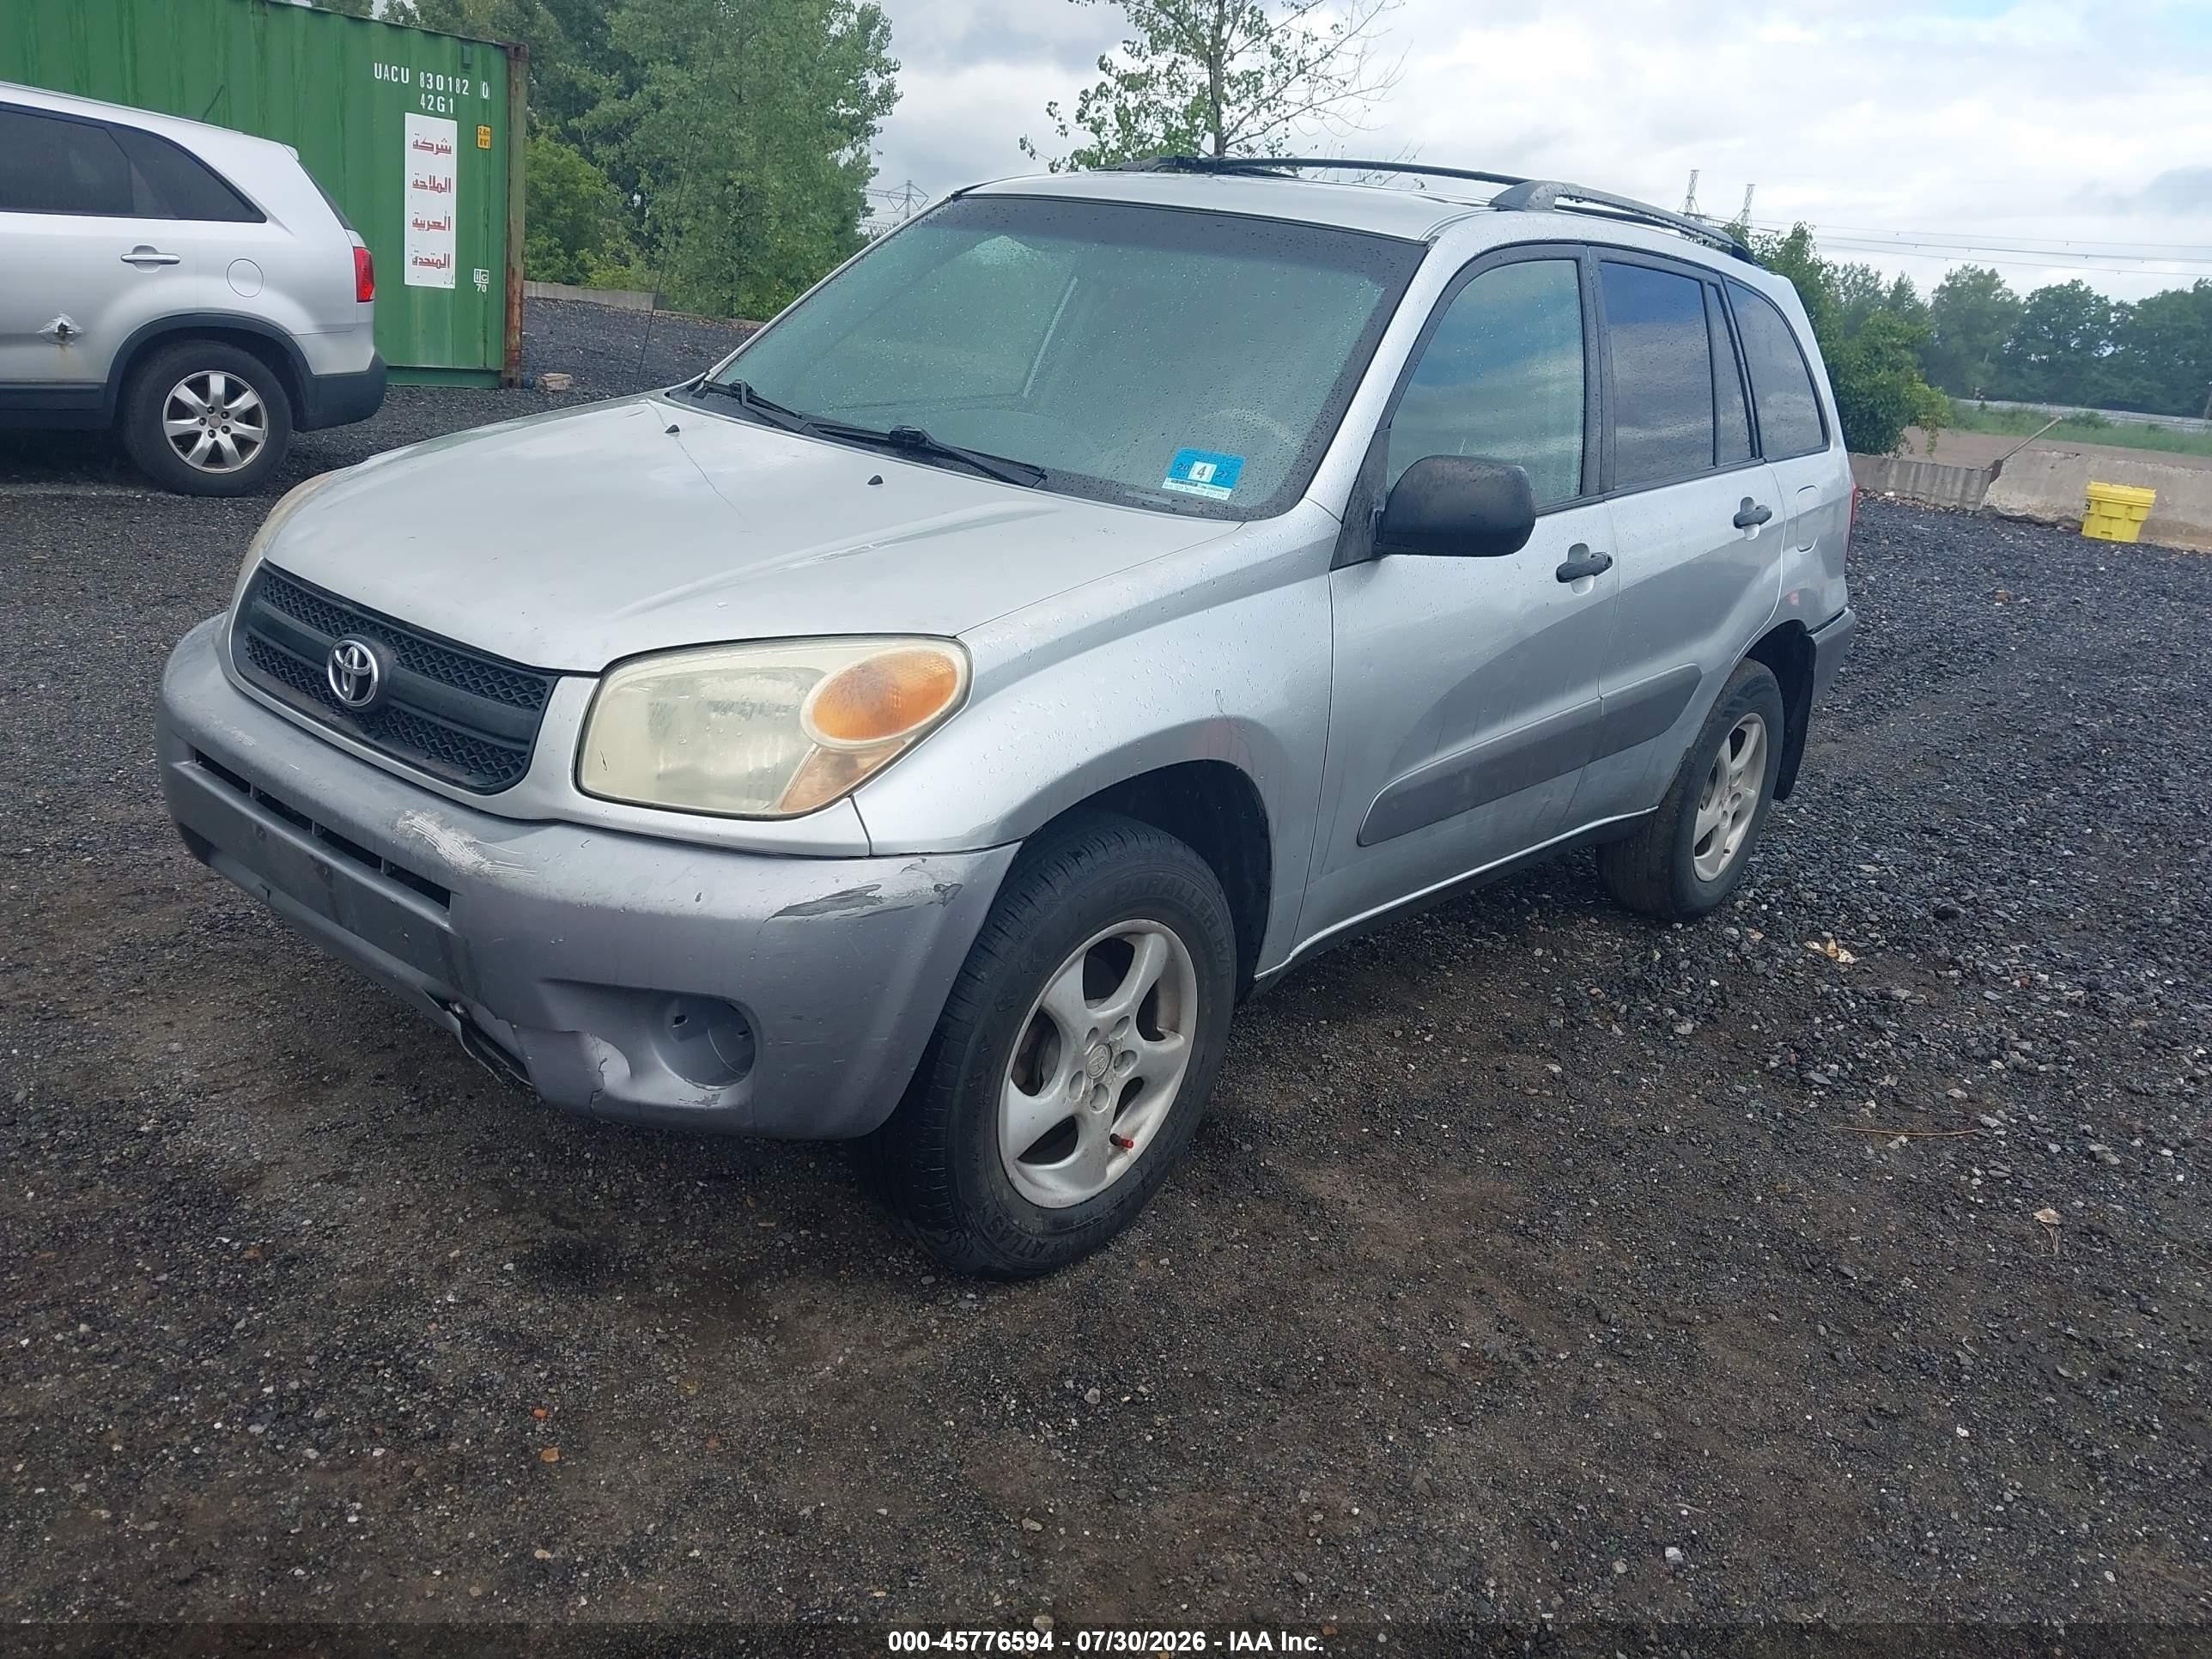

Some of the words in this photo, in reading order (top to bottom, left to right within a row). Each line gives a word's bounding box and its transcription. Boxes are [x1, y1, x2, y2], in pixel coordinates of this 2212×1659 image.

[374, 62, 410, 85] UACU
[419, 71, 471, 96] 830182
[420, 93, 454, 115] 42G1
[411, 132, 453, 155] شركة
[411, 173, 452, 194] الملاحة
[411, 210, 452, 232] العربية
[411, 249, 451, 270] المتحدة
[476, 283, 487, 293] 70
[1196, 465, 1207, 479] 4
